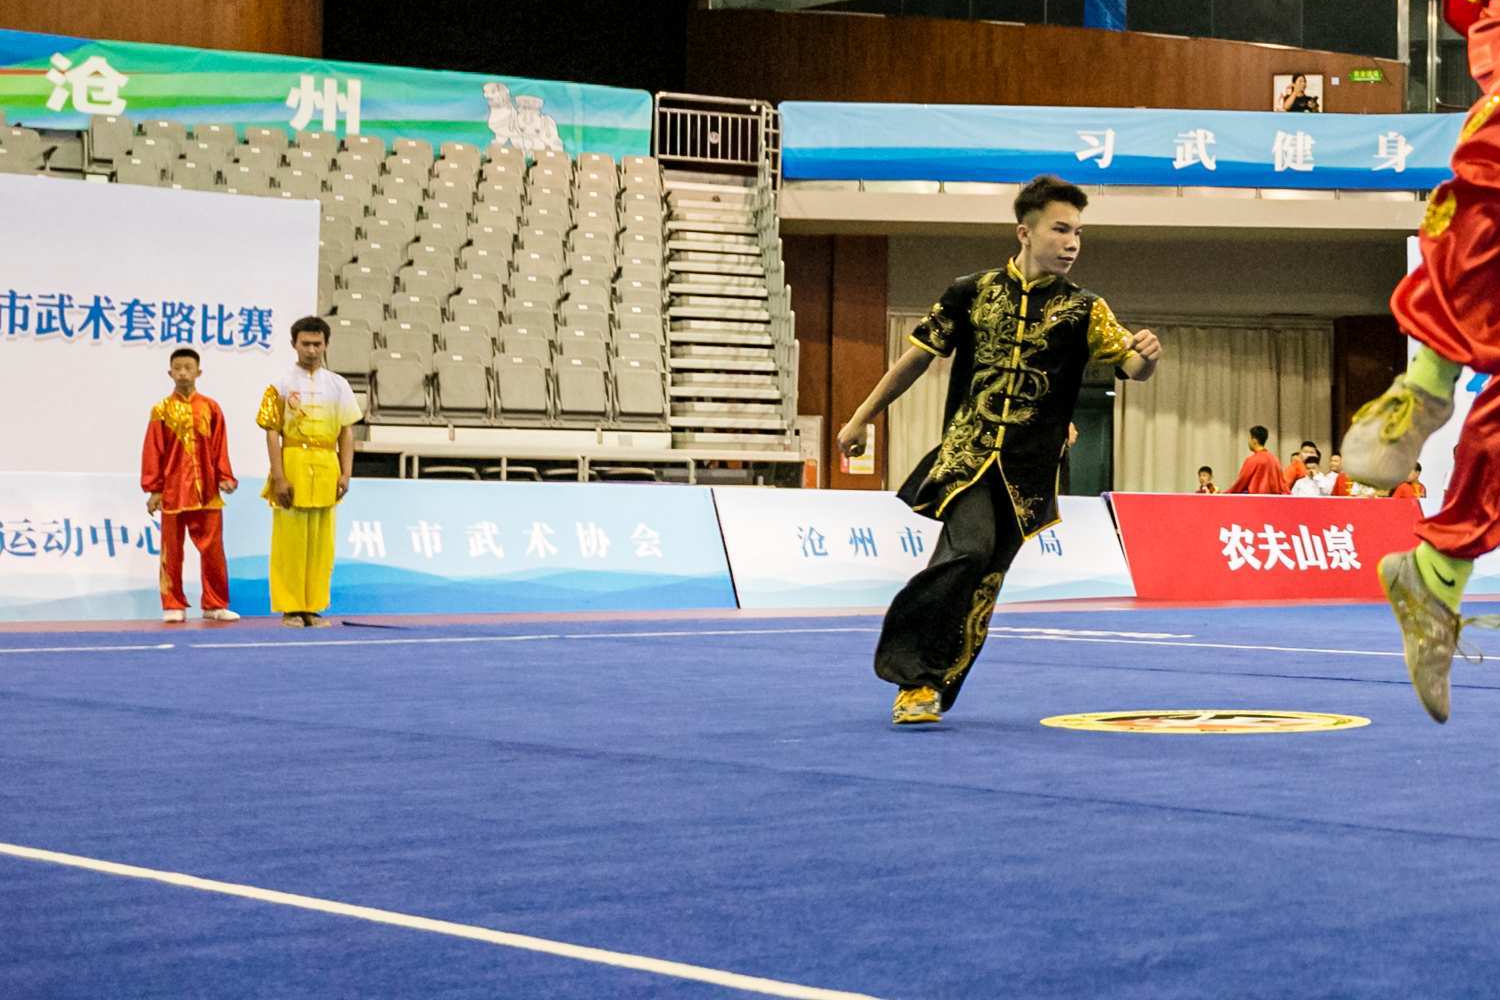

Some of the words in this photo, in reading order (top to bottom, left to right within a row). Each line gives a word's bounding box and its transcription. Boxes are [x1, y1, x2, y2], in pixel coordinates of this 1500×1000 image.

[46, 53, 362, 134] 沧州
[1075, 129, 1414, 173] 习武健身
[0, 289, 273, 349] 市武术套路比赛
[1219, 523, 1362, 571] 农夫山泉
